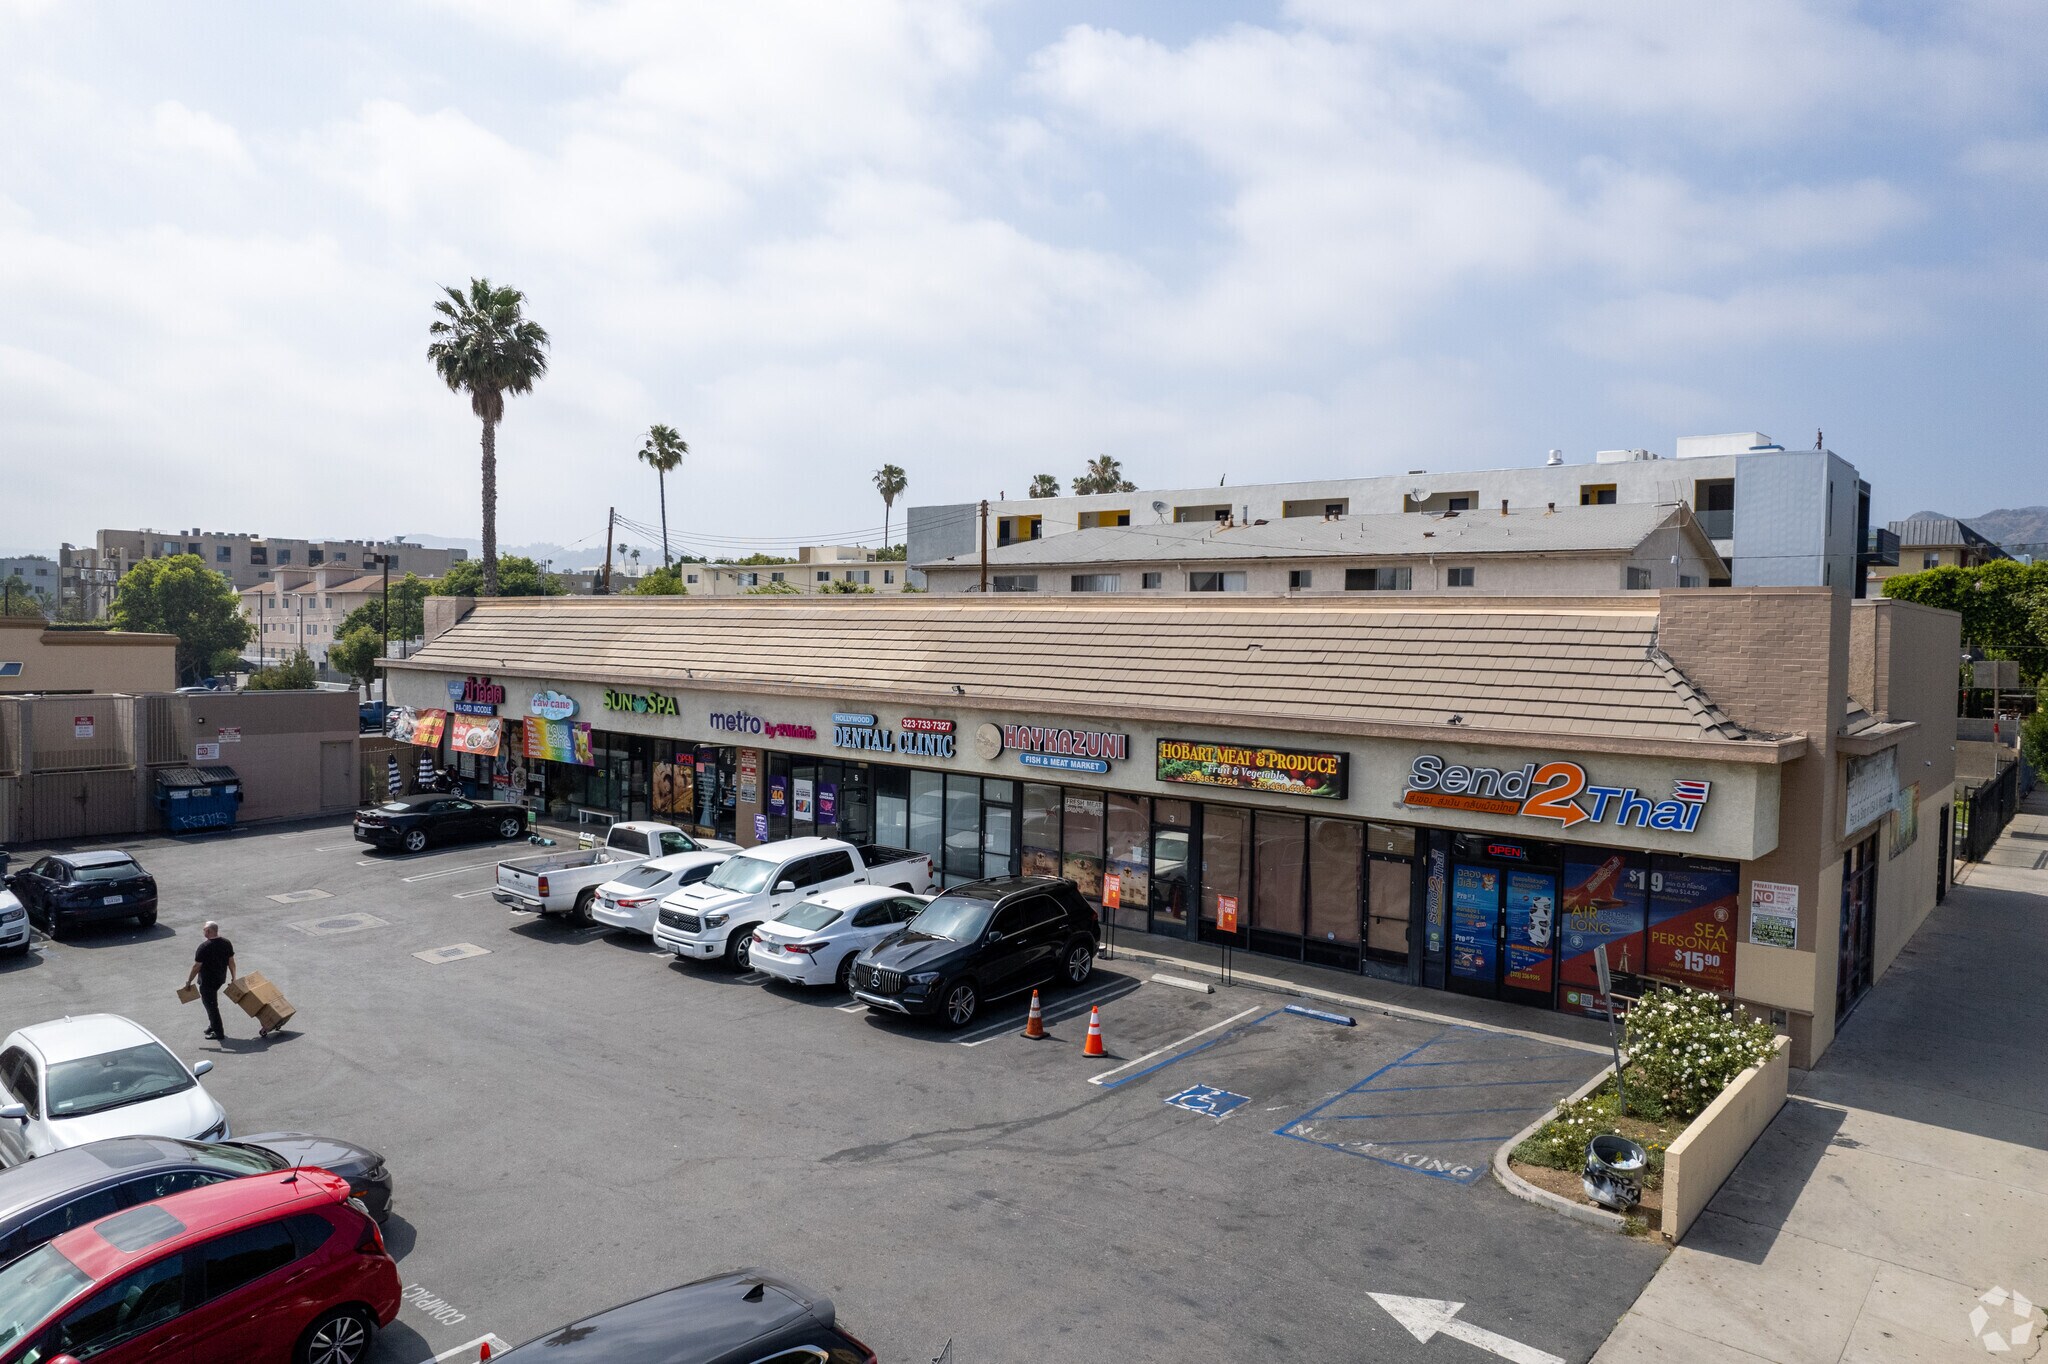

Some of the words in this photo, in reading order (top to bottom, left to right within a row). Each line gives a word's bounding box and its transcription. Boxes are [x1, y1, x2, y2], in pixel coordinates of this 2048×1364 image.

[533, 699, 549, 707] raw
[550, 700, 570, 709] cane
[603, 689, 633, 712] SUN
[647, 692, 676, 715] SPA
[473, 705, 492, 714] NOODLE
[710, 711, 761, 734] metro
[835, 714, 870, 724] HOLLYWOOD
[832, 726, 893, 753] DENTAL
[897, 731, 953, 759] CLINIC
[1004, 724, 1126, 760] HAYKAZUNI
[676, 753, 694, 765] OPEN
[1025, 756, 1041, 765] FISH
[1042, 757, 1049, 765] &
[1050, 758, 1069, 767] MEAT
[1070, 760, 1100, 770] MARKET
[1161, 743, 1214, 763] HOBART
[1216, 748, 1253, 766] MEAT
[1256, 752, 1266, 766] &
[1269, 753, 1337, 775] PRODUCE
[1207, 764, 1230, 776] Fruit
[1232, 767, 1239, 776] &
[1241, 768, 1286, 781] Vegetable
[1182, 773, 1239, 786] 323.465.2224
[1251, 780, 1312, 794] 323.460.4462
[996, 792, 1001, 800] 4
[1169, 814, 1175, 822] 3
[1387, 842, 1394, 850] 2
[1488, 845, 1521, 857] OPEN
[499, 876, 537, 890] CHEVROLET
[1109, 884, 1119, 892] ONLY
[1754, 882, 1772, 890] PRIVATE
[1773, 885, 1797, 893] PROPERTY
[1456, 892, 1467, 900] Pro
[1754, 891, 1774, 903] NO
[1225, 906, 1236, 914] ONLY
[1571, 904, 1598, 920] AIR
[1570, 918, 1611, 935] LONG
[1694, 922, 1728, 941] SEA
[1455, 934, 1465, 942] Pro
[1652, 931, 1728, 954] PERSONAL
